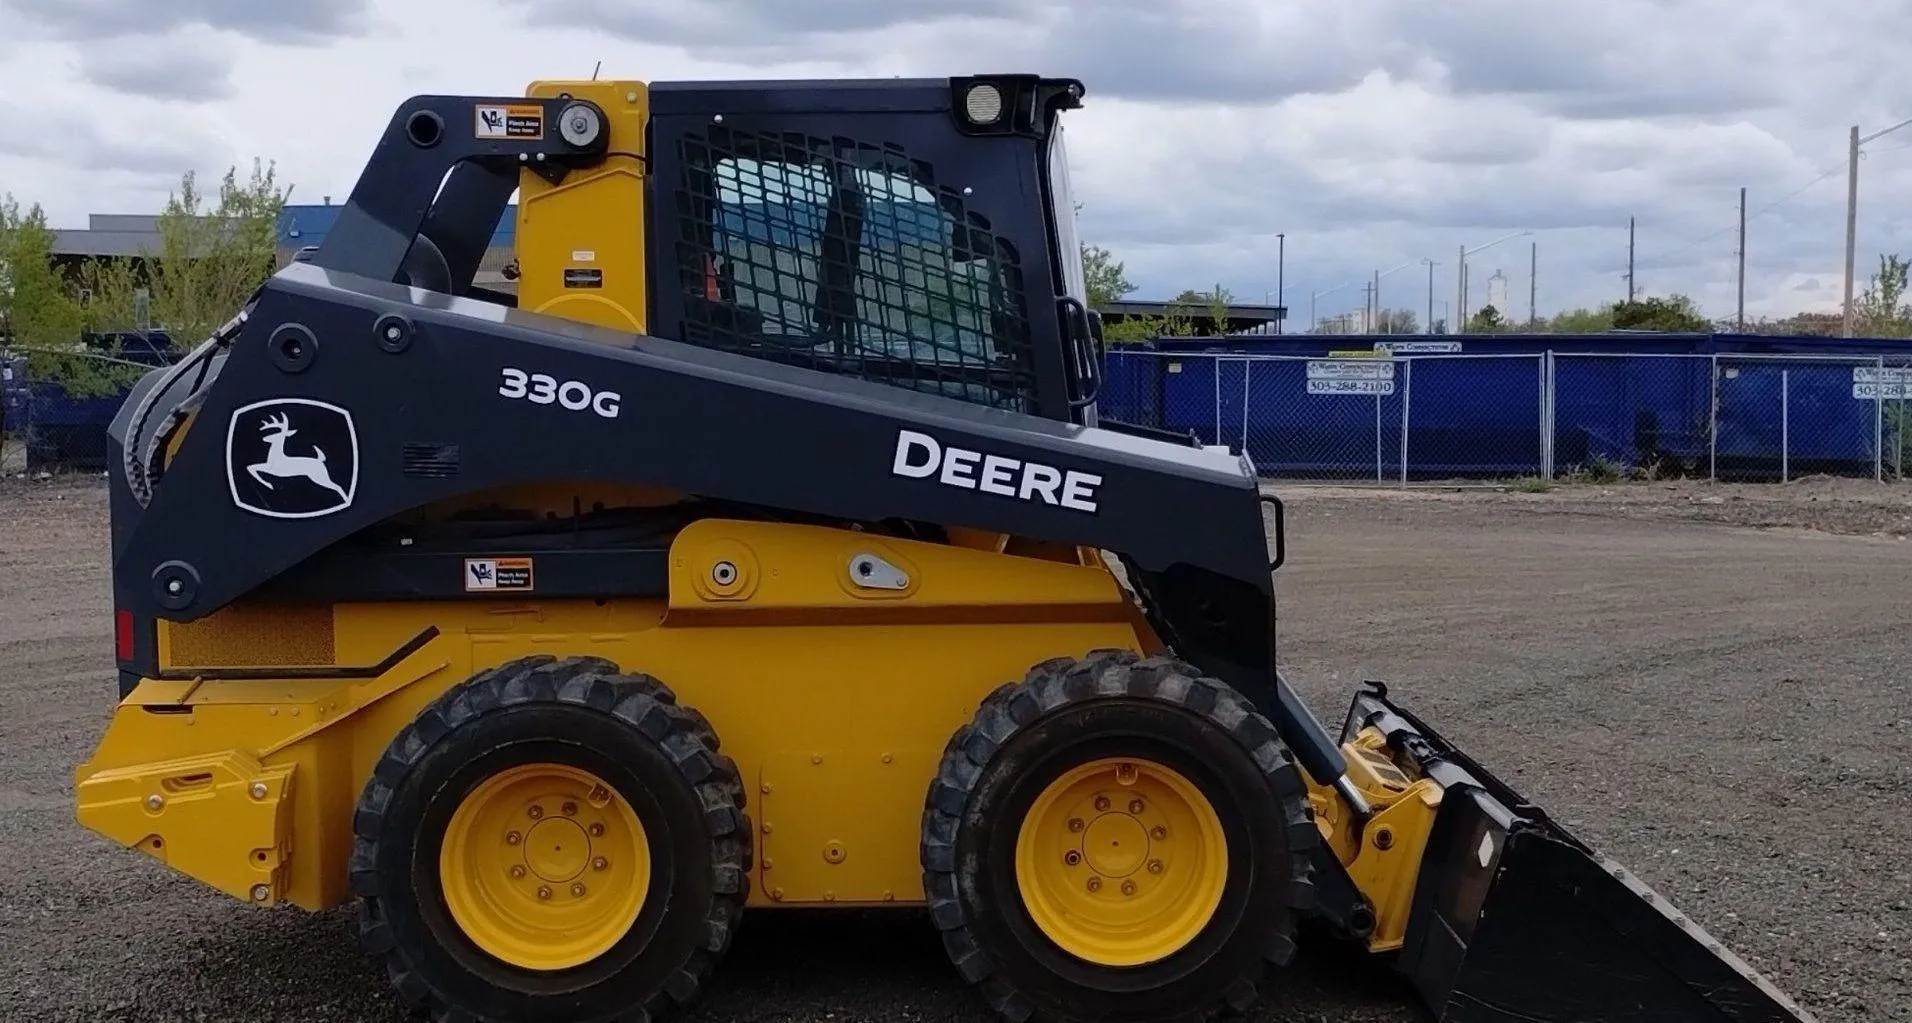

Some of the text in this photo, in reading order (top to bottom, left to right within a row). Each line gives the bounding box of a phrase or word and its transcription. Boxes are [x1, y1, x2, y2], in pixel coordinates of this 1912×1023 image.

[499, 368, 621, 418] 330G
[1309, 381, 1392, 392] 303-288-2100
[892, 429, 1103, 513] DEERE
